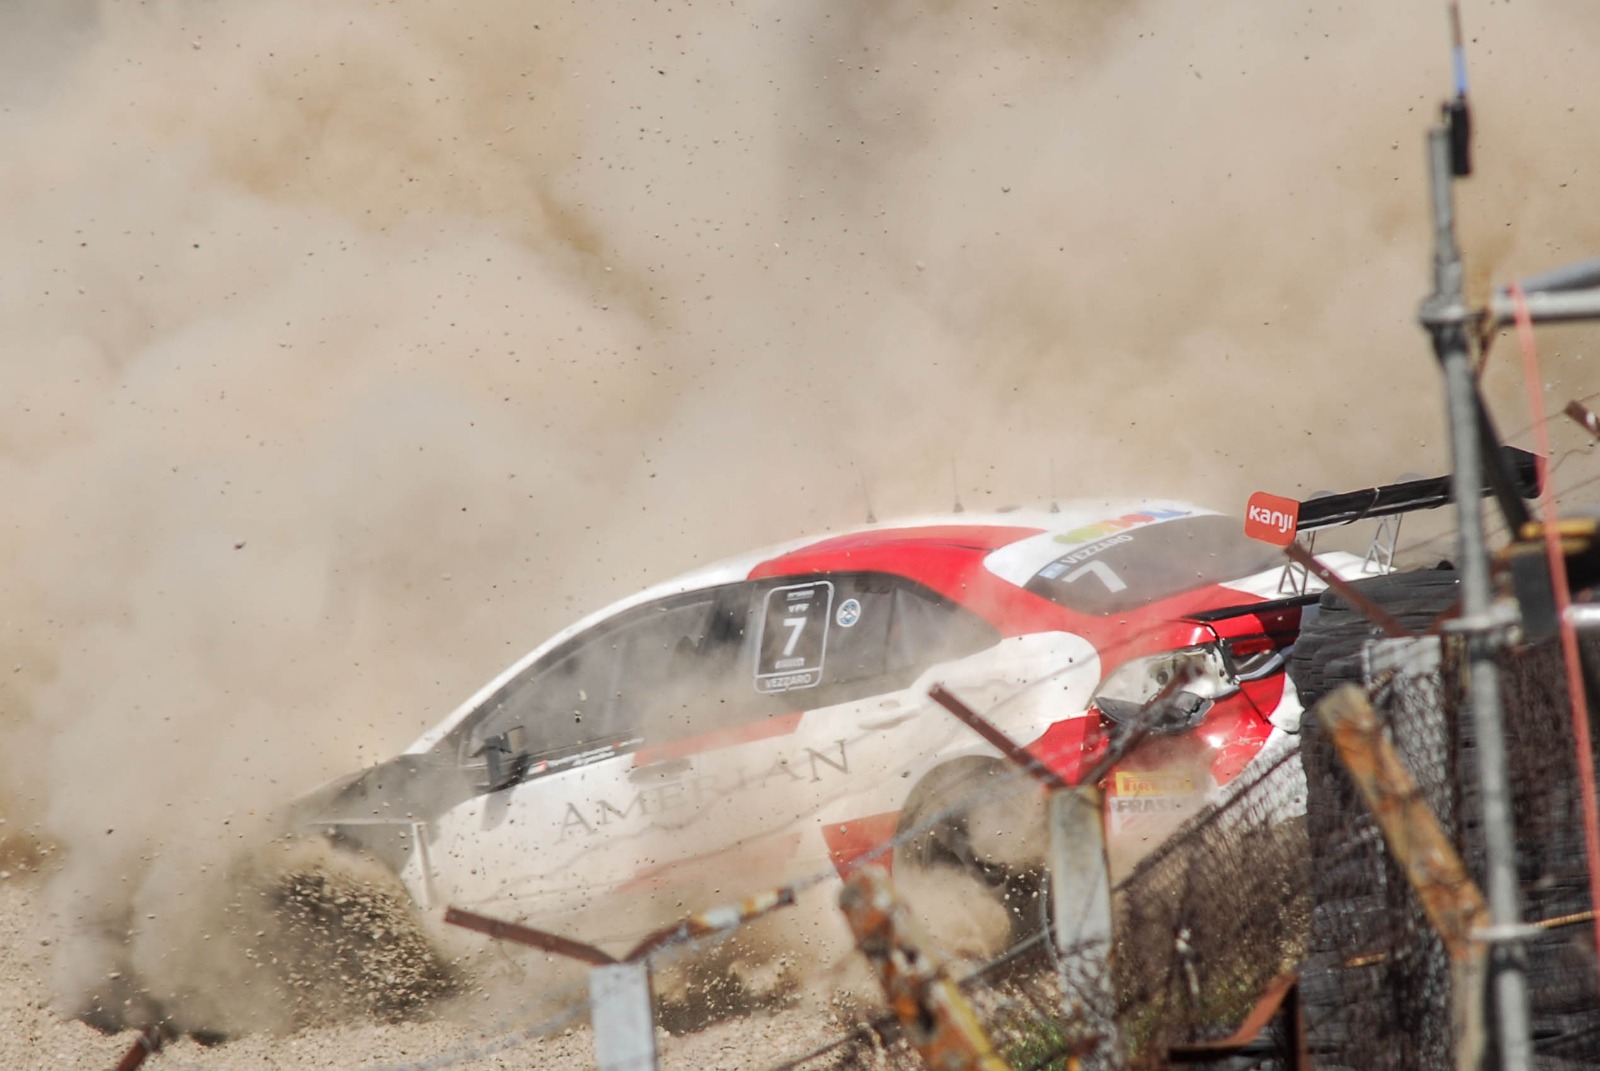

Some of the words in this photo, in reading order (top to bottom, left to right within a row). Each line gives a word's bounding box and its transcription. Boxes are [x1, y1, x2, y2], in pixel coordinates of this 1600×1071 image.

[1249, 505, 1293, 534] kanji
[1060, 533, 1134, 565] VEZZARO
[1062, 559, 1128, 593] 7
[783, 617, 807, 656] 7
[765, 673, 811, 689] VEZZARO
[553, 738, 851, 846] AMERIAN
